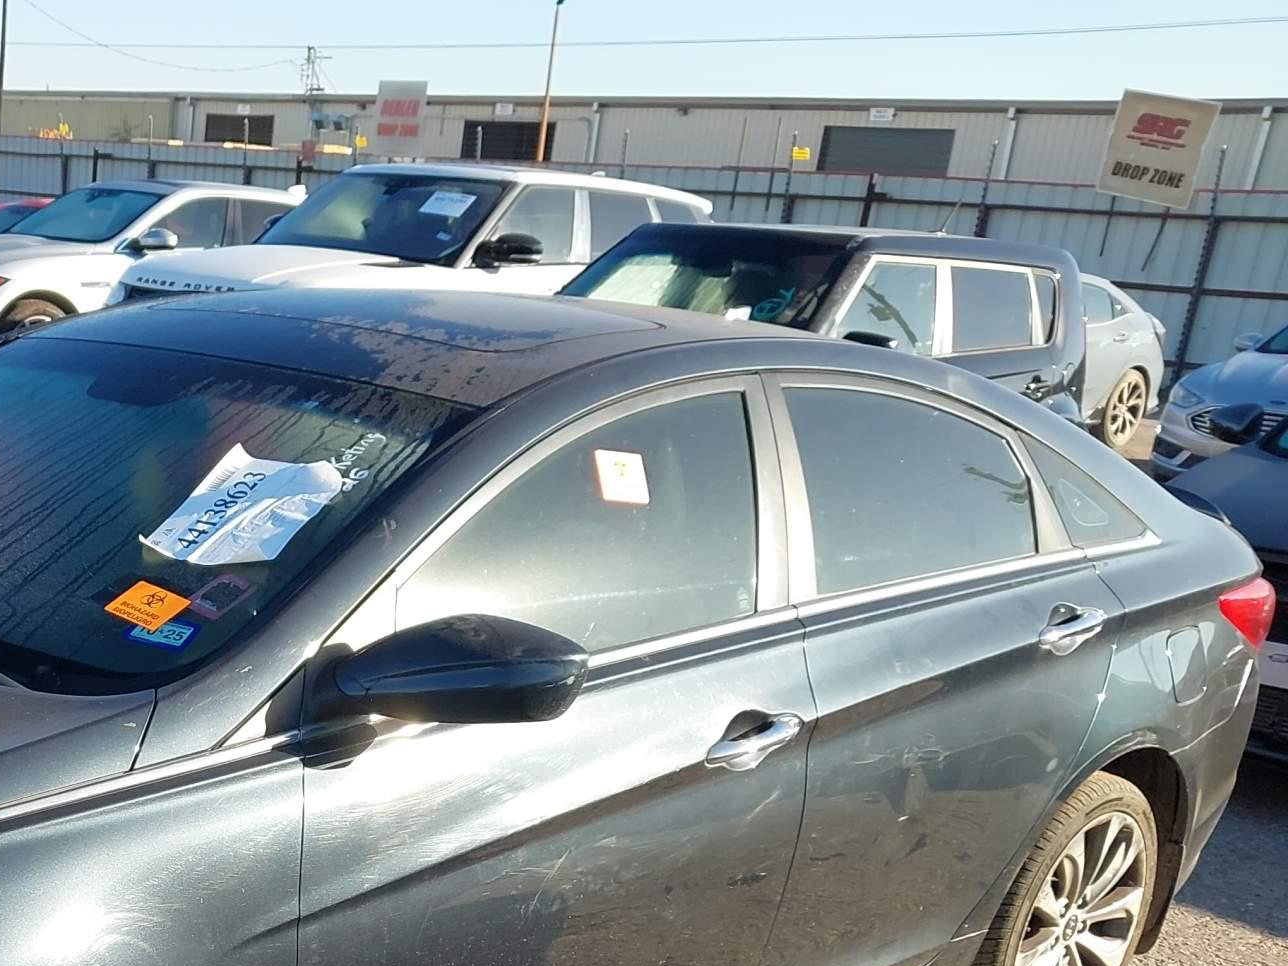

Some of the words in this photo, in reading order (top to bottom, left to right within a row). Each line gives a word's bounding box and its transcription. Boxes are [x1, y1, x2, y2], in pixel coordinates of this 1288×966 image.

[1111, 160, 1150, 181] DROP
[1149, 168, 1187, 189] ZONE
[136, 276, 177, 287] RANGE
[182, 282, 236, 293] ROVER
[177, 471, 266, 550] 44138623
[119, 600, 161, 620] BIOHAZARD
